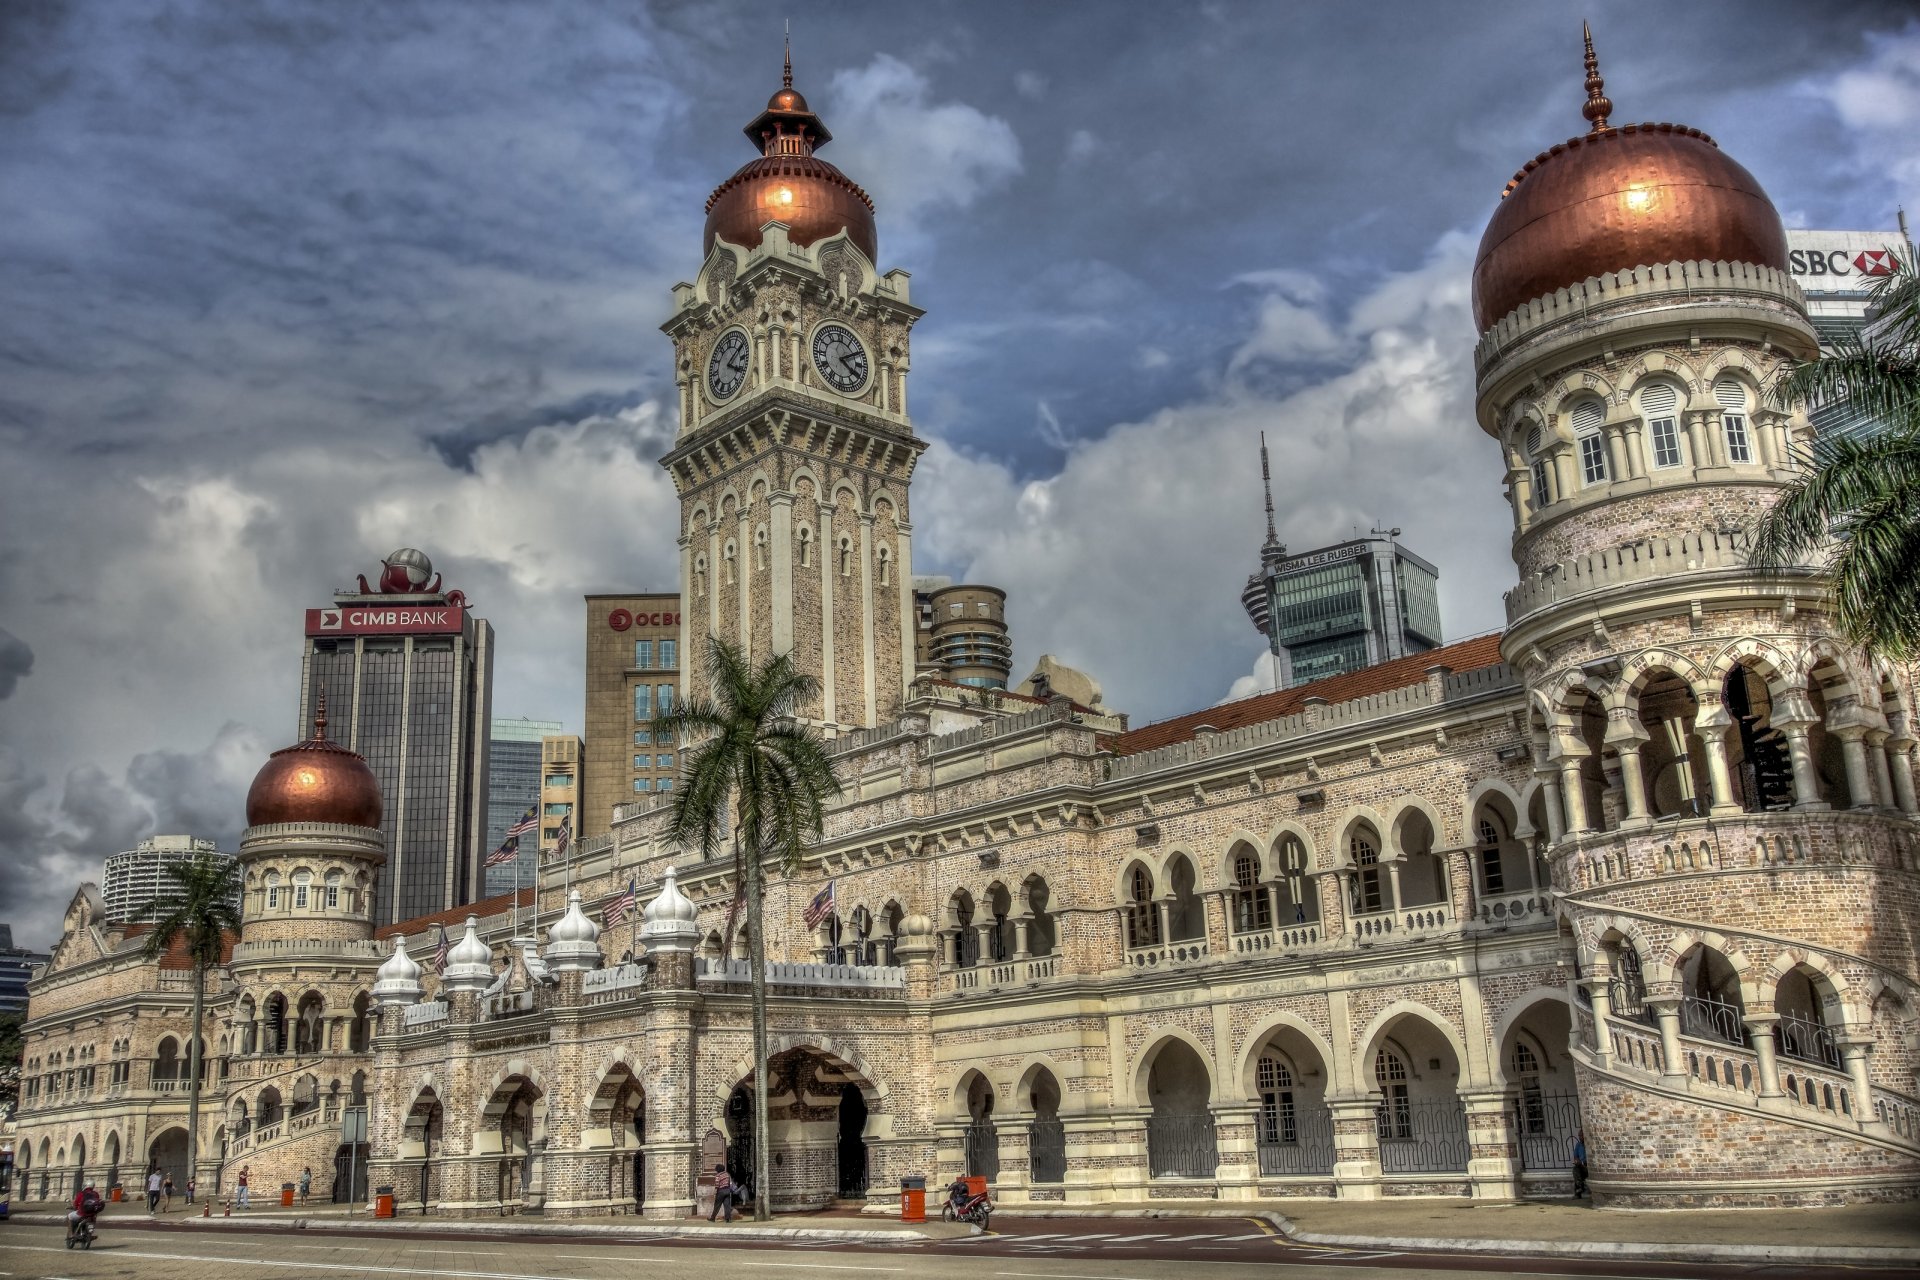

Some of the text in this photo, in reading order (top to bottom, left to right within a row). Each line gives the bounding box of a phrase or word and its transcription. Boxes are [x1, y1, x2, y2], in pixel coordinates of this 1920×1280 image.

[1790, 250, 1850, 276] SBC
[1274, 544, 1367, 573] WISMA LEE RUBBER
[349, 612, 447, 625] CIMB BANK
